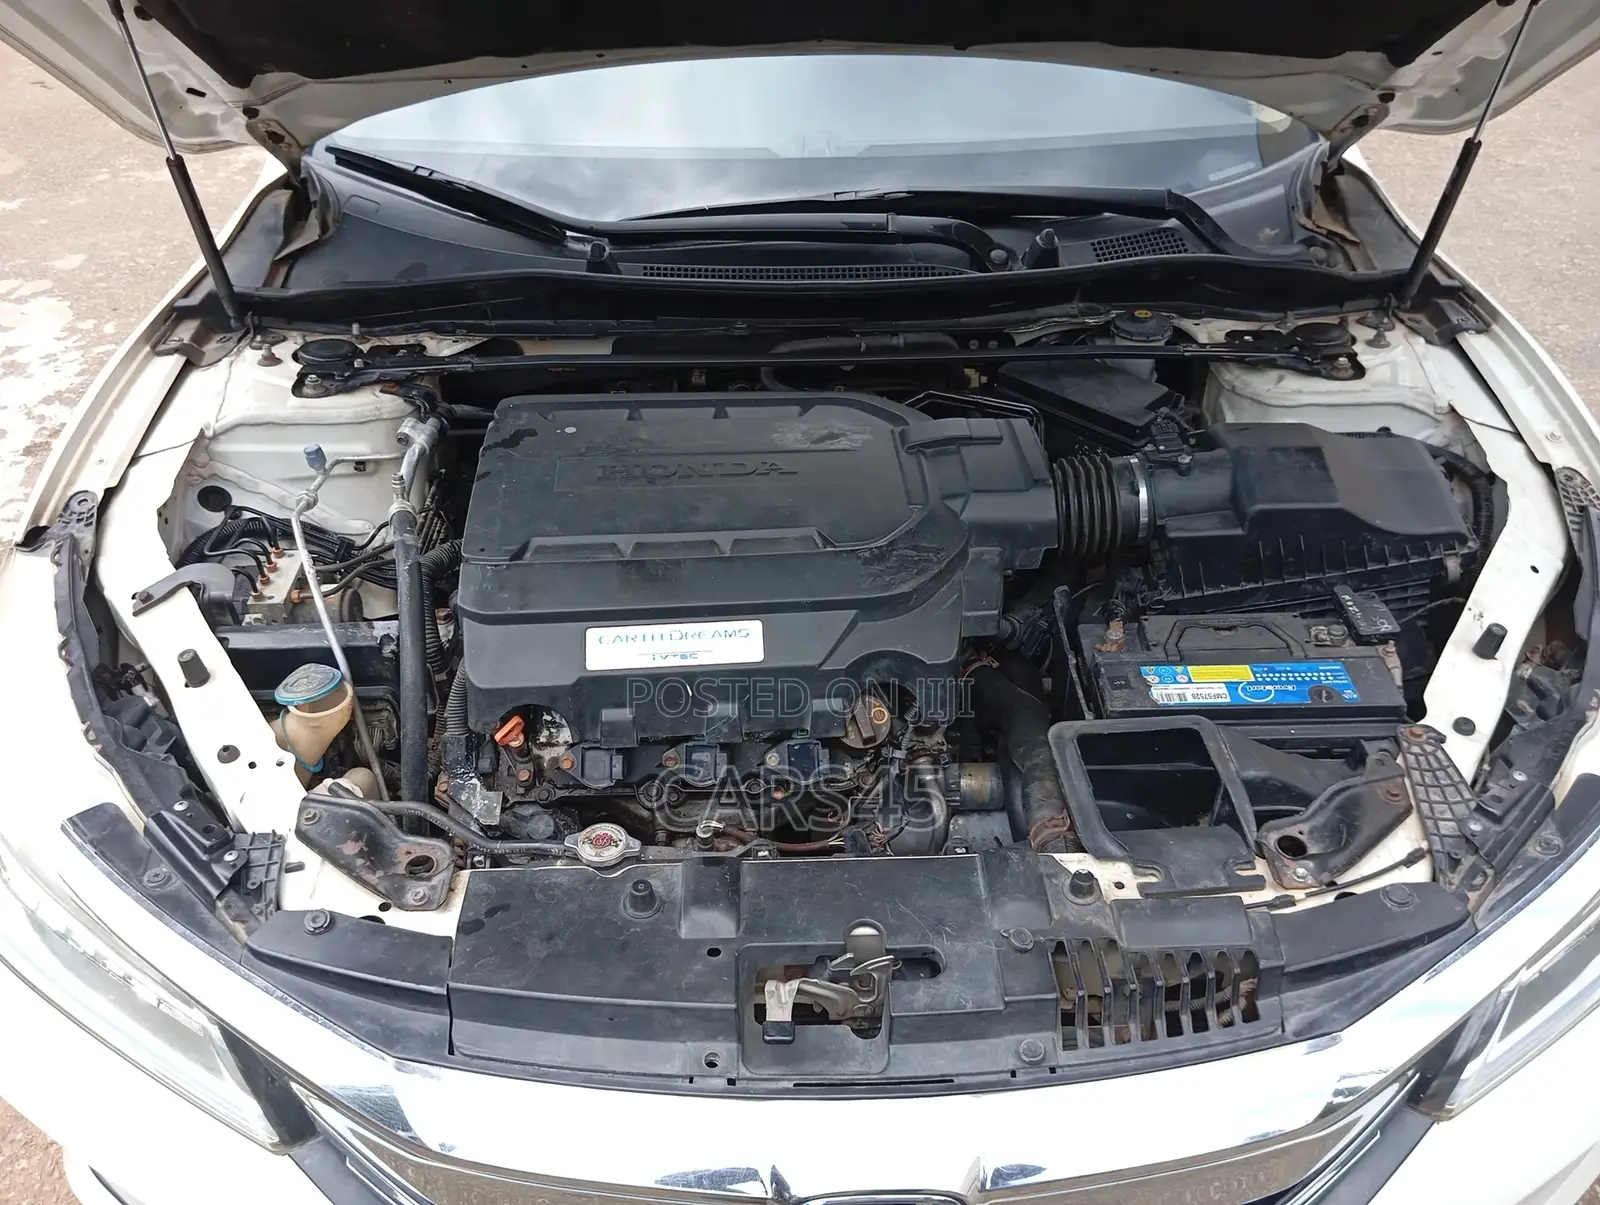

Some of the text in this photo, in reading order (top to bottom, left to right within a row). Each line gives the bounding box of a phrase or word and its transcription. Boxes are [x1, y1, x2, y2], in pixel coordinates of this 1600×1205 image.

[597, 461, 798, 484] HONDA
[598, 628, 750, 645] EARTH DREAMS
